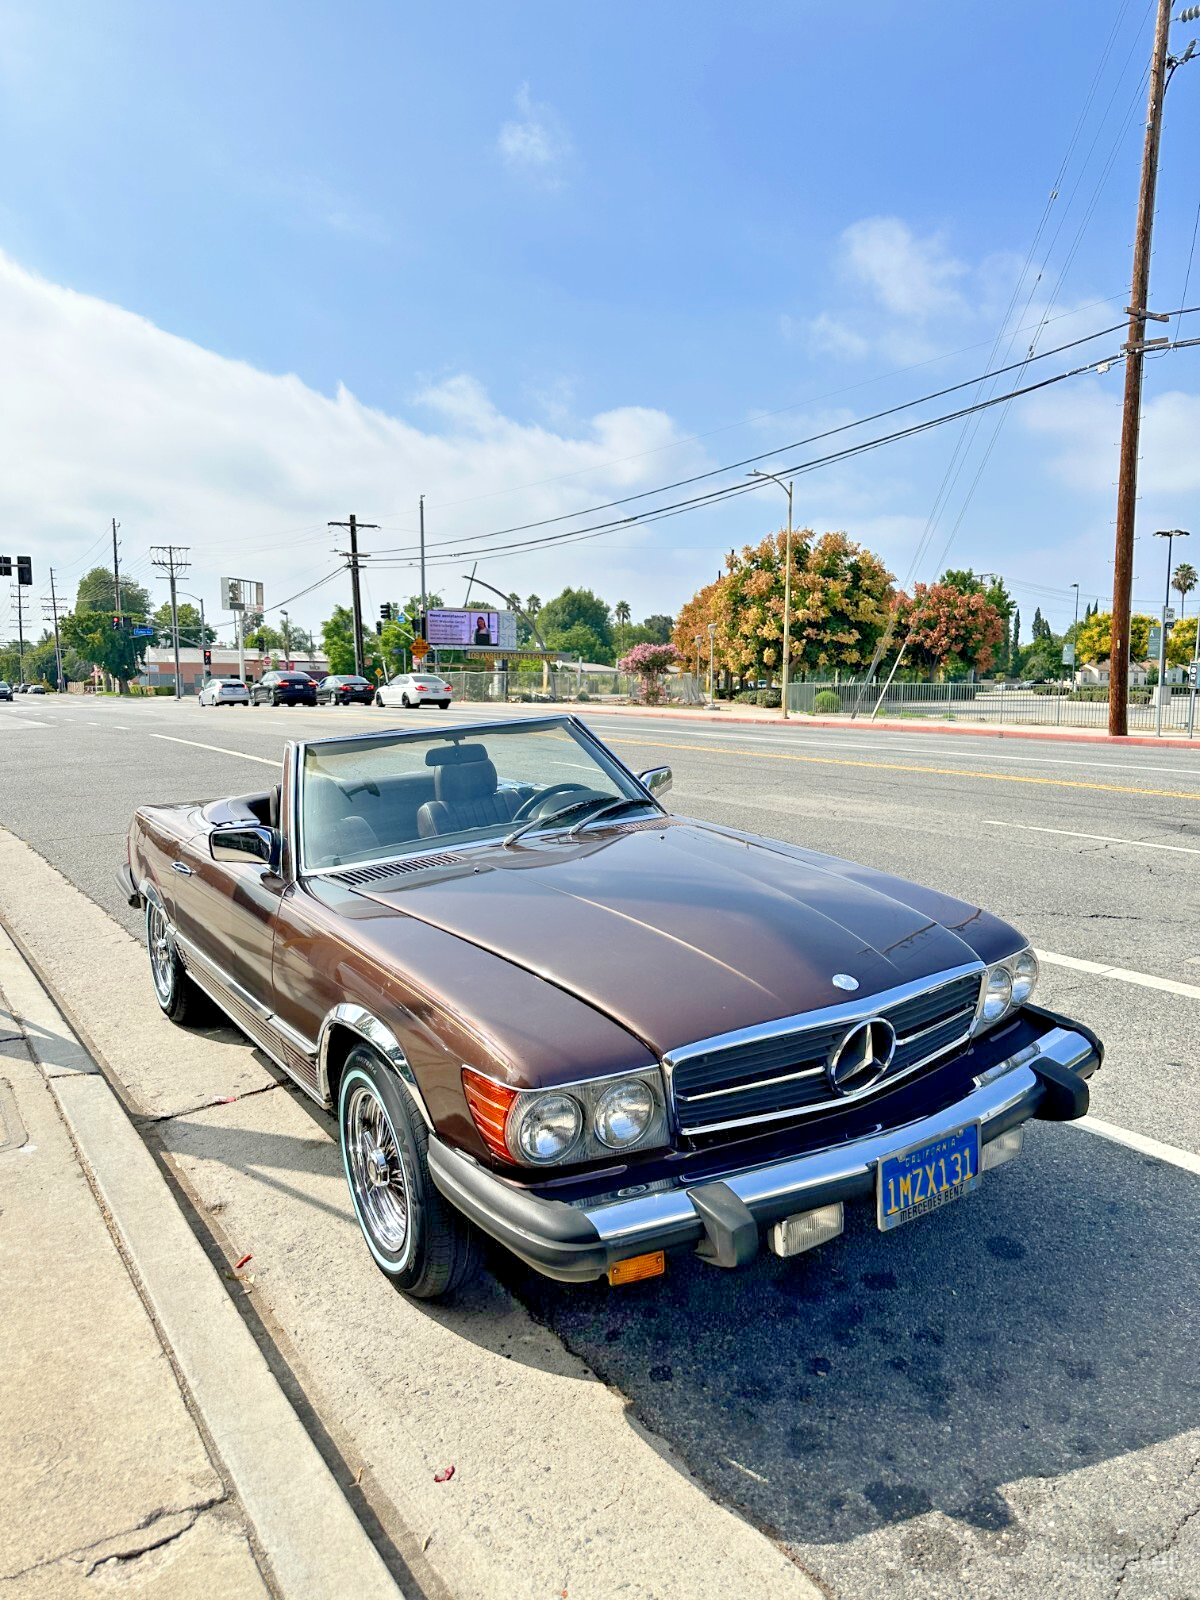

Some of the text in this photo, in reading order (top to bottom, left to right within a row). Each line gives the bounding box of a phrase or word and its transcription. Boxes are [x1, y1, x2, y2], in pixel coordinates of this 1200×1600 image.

[905, 1138, 956, 1168] CALIFORNIA
[887, 1147, 973, 1215] 1MZX131
[899, 1183, 965, 1224] MERCEDES BENZ
